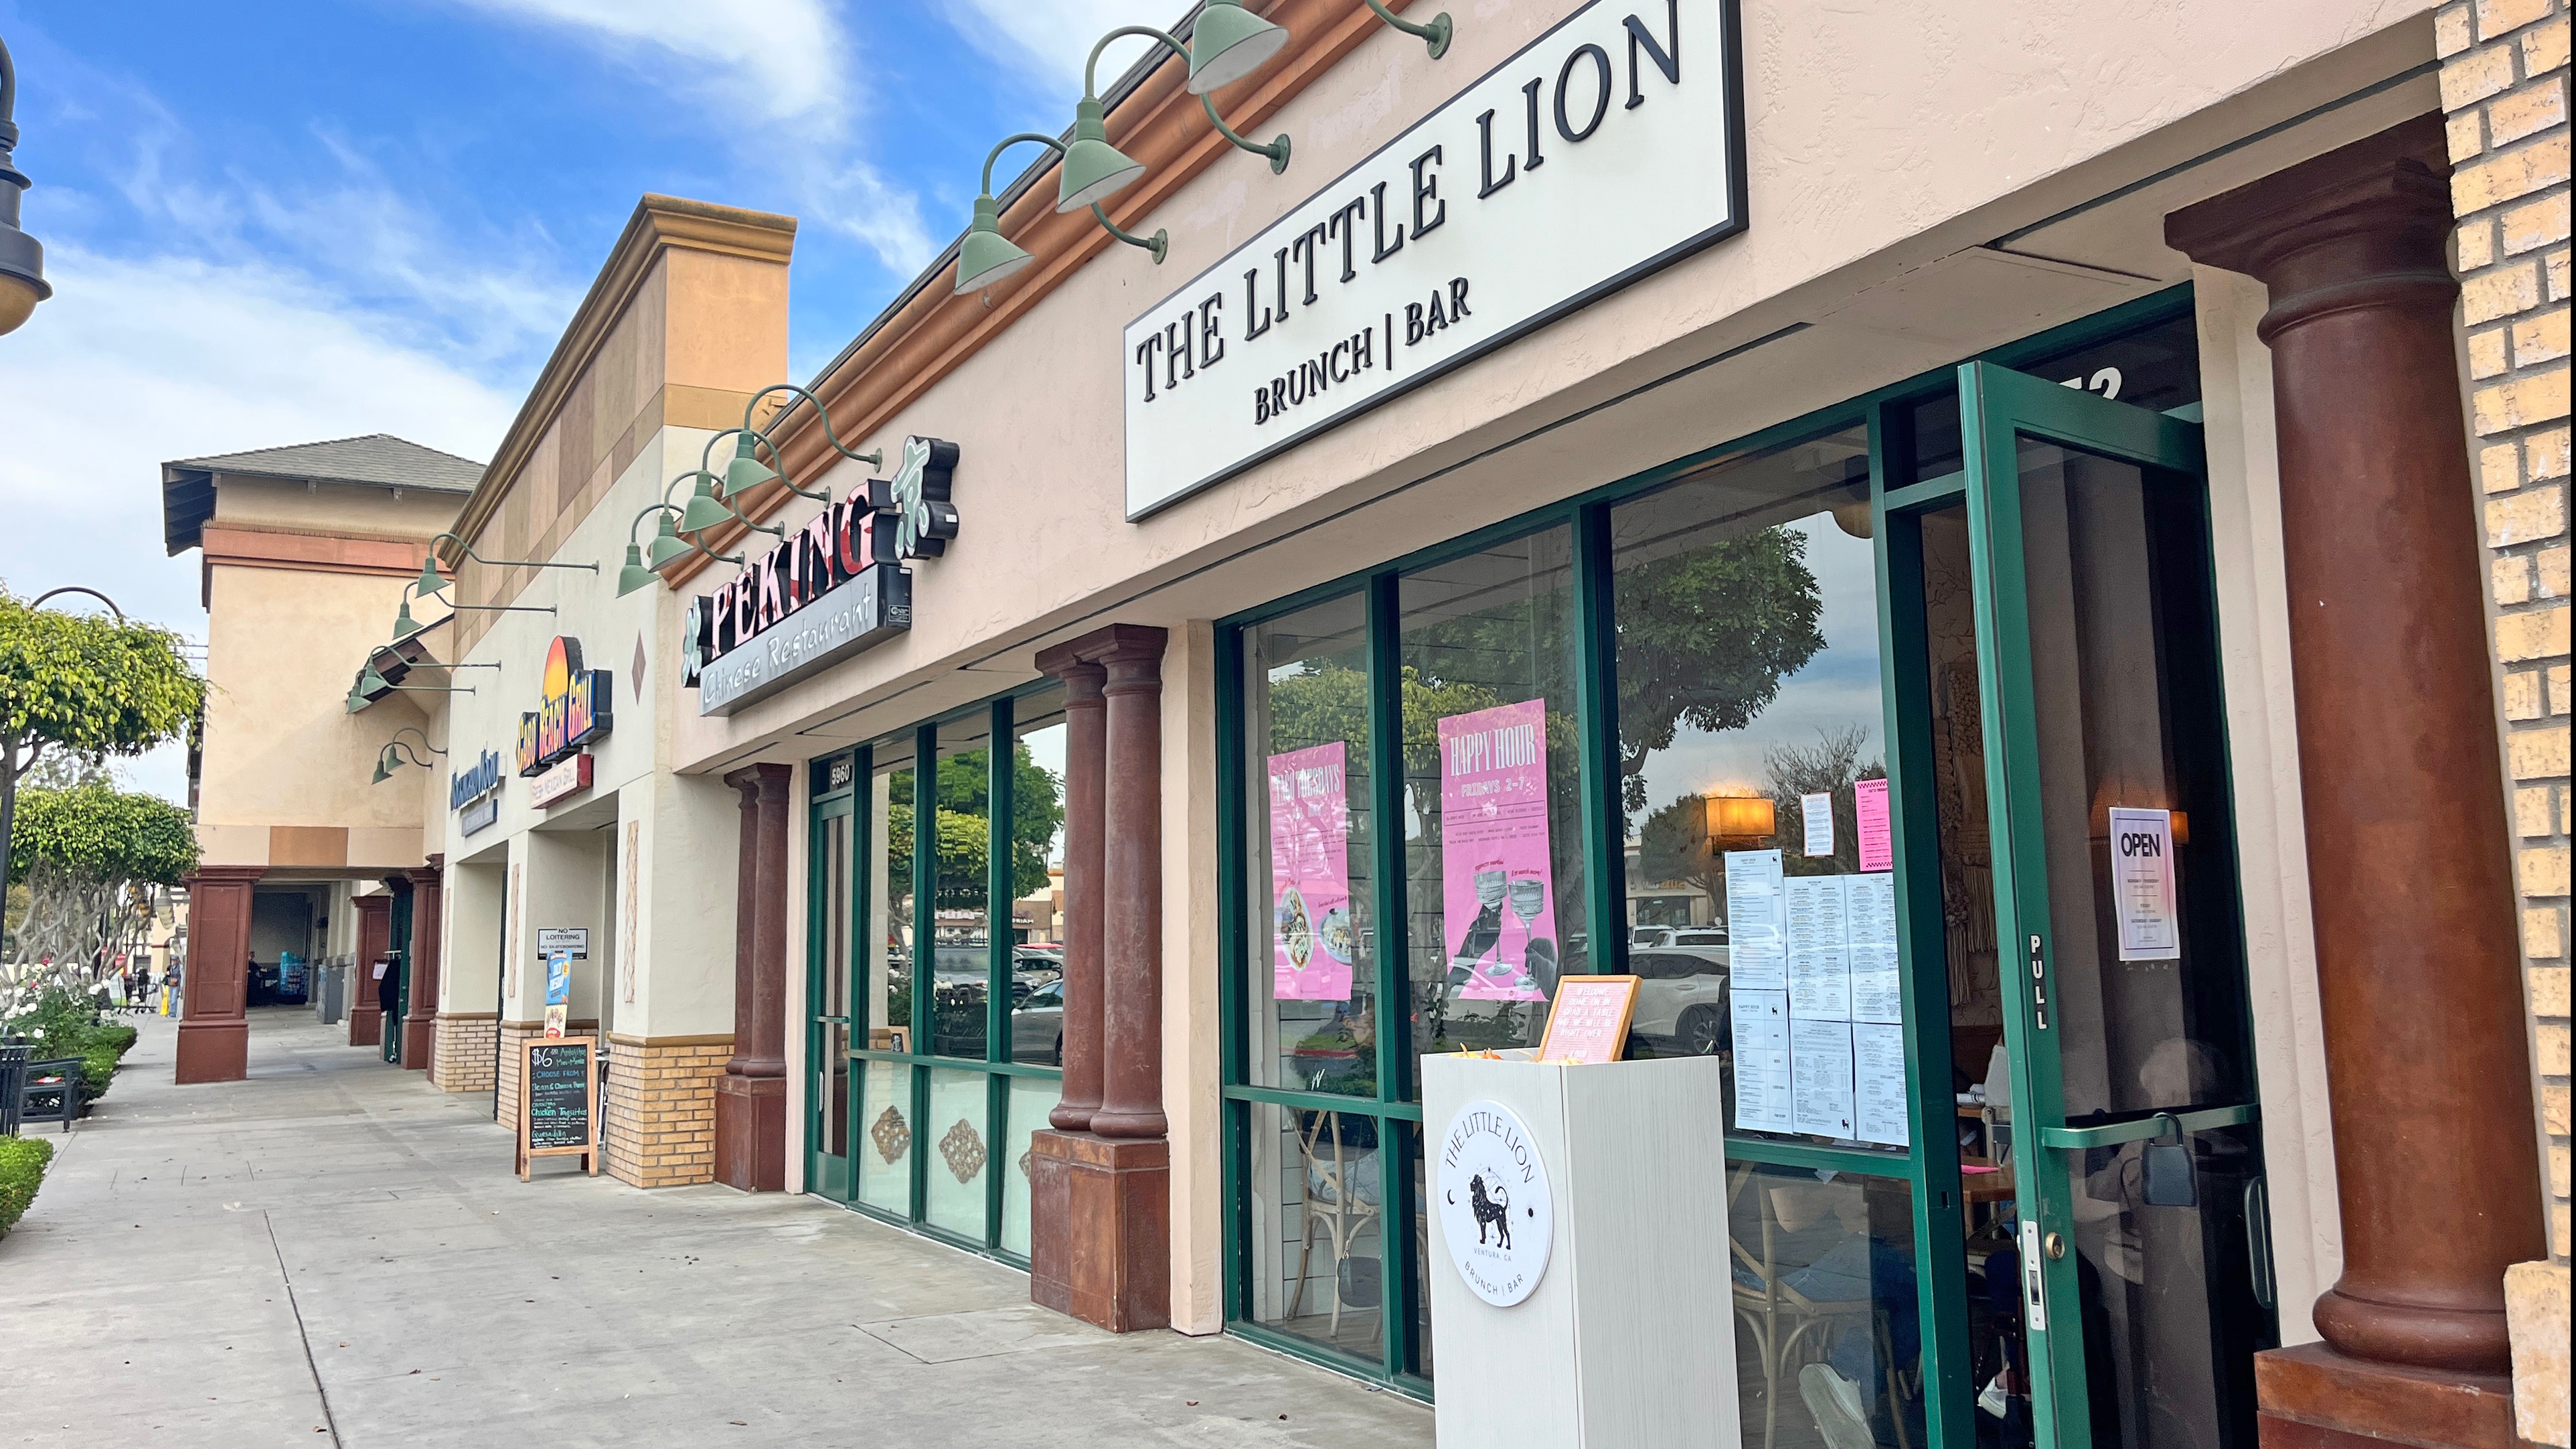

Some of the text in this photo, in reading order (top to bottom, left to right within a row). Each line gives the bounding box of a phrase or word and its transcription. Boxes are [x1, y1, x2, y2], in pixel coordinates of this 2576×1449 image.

[1136, 0, 1681, 404] THE LITTLE LION
[1253, 327, 1373, 425] BRUNCH
[1404, 277, 1472, 347] BAR
[712, 479, 876, 661] PEKING
[704, 581, 872, 704] Chinese Restaurant
[517, 672, 592, 775] CABO BEACH GRILL
[1450, 723, 1536, 776] HAPPY HOUR
[831, 764, 850, 785] 5960
[1295, 763, 1340, 799] TUESDAYS
[1461, 776, 1525, 797] FRIDAYS 2-7
[2121, 832, 2161, 857] OPEN
[1577, 988, 1609, 996] WELCOME
[2030, 935, 2047, 1030] PULL
[1563, 1008, 1614, 1016] GRAB A TABLE
[1570, 997, 1611, 1006] COME ON IN
[1556, 1018, 1569, 1026] AND
[1573, 1018, 1583, 1026] WE
[1585, 1018, 1601, 1026] WILL
[1560, 1028, 1602, 1037] RIGHT OVER
[532, 1047, 553, 1067] $6
[536, 1071, 560, 1079] CHOOSE
[531, 1107, 587, 1118] Chicken Taquitos
[532, 1129, 567, 1139] Quesadilla
[1445, 1112, 1534, 1183] THE LITTLE LION
[1504, 1251, 1512, 1262] CA
[1465, 1260, 1498, 1295] BRUNCH
[1508, 1273, 1524, 1293] BAR
